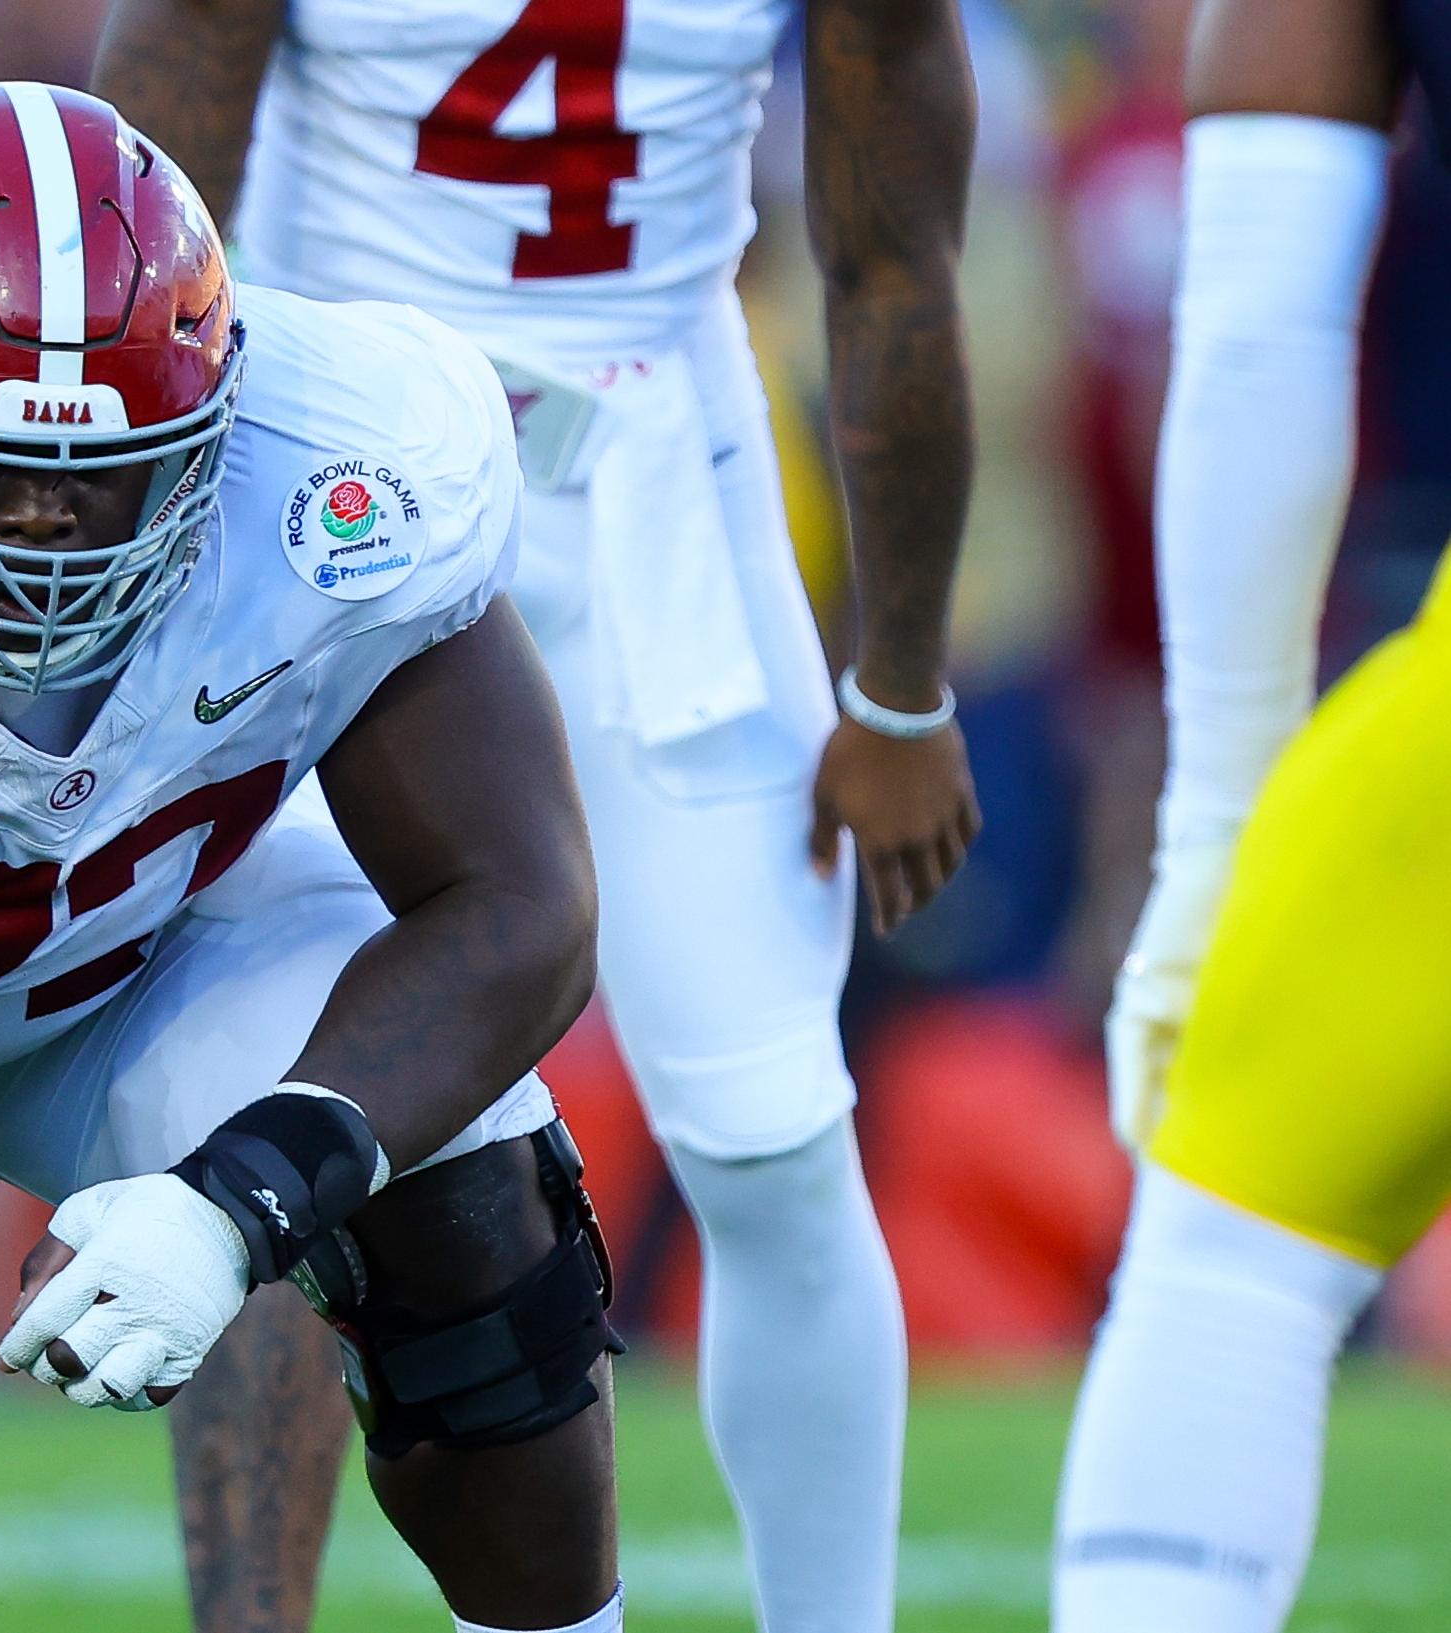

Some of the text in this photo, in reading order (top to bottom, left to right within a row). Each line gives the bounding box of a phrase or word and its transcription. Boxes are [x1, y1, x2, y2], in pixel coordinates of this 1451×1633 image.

[414, 0, 642, 280] 4
[22, 399, 94, 424] BAMA
[287, 460, 421, 547] ROSE BOWL GAME
[329, 536, 391, 561] presented by
[339, 553, 413, 580] Prudential
[57, 773, 85, 805] A
